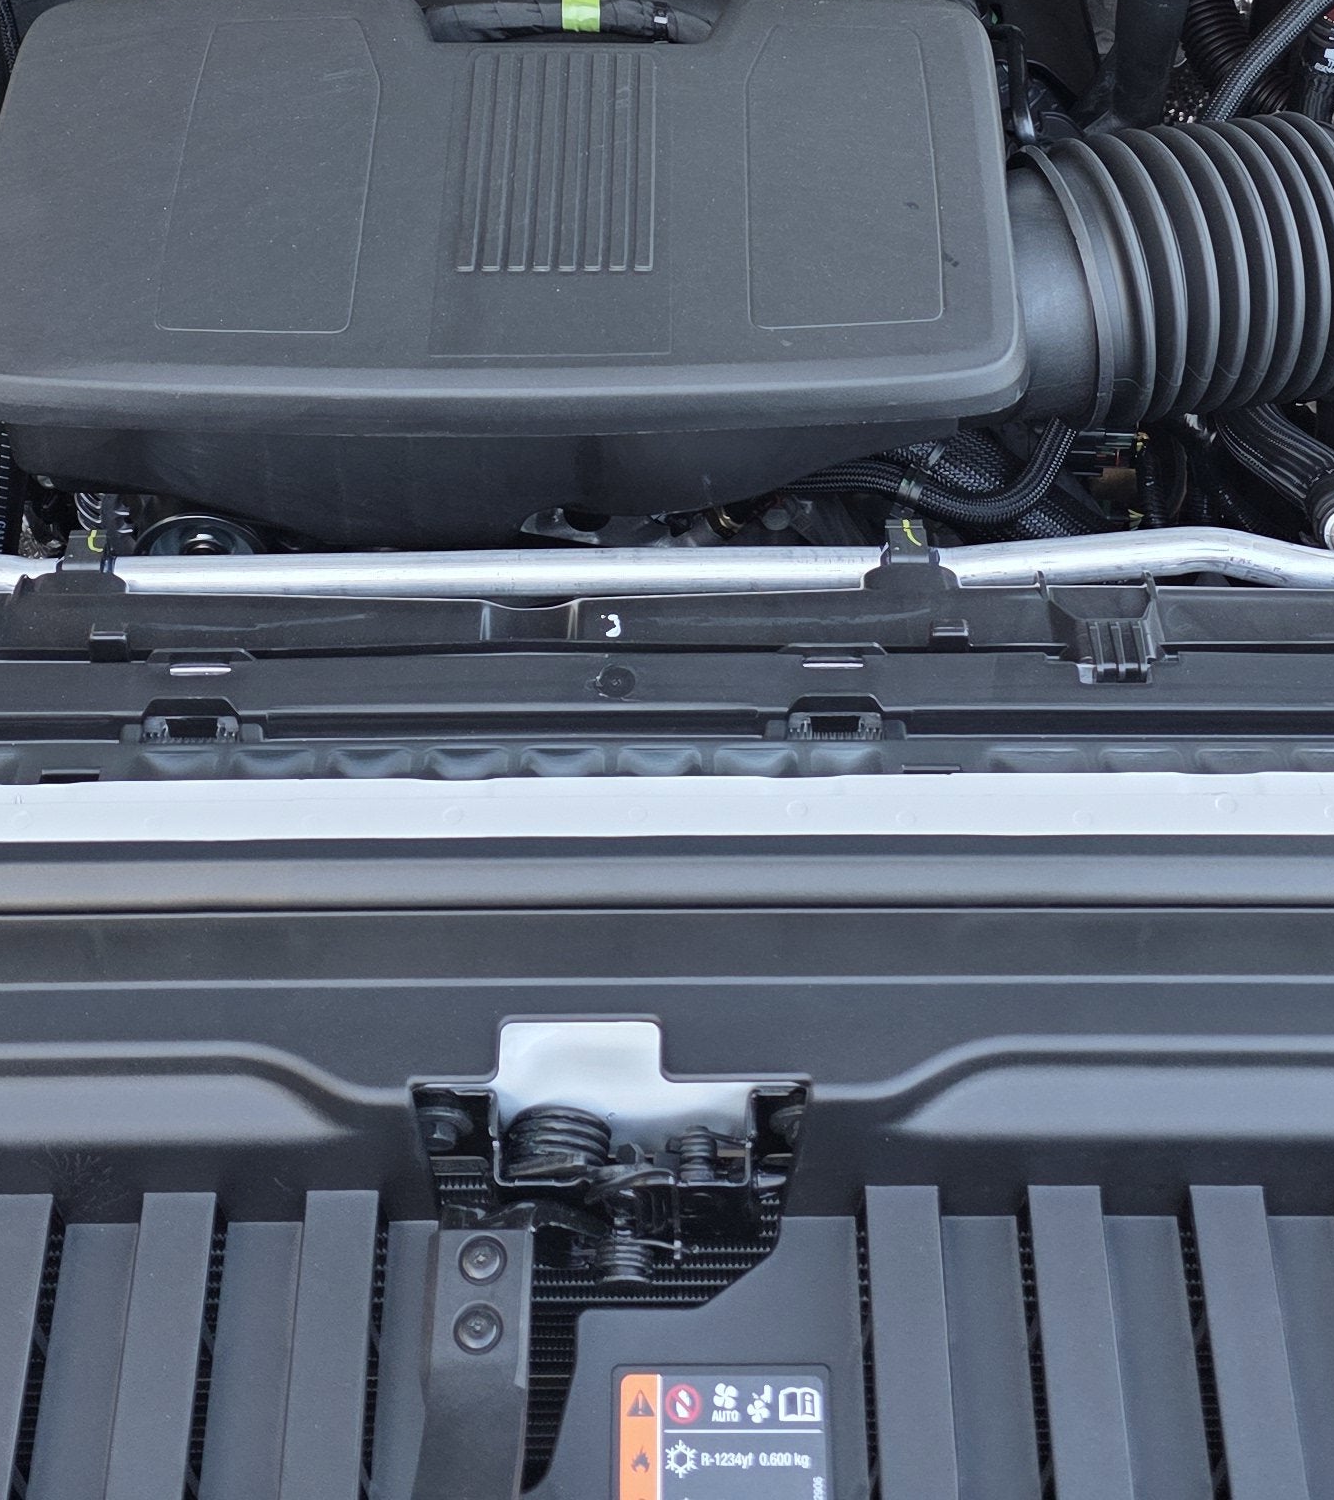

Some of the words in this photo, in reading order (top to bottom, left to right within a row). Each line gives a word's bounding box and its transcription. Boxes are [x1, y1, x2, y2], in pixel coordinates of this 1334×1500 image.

[711, 1409, 739, 1422] AUTO
[700, 1452, 753, 1469] R-1234yf
[758, 1452, 792, 1467] 0.600
[793, 1452, 811, 1469] kg
